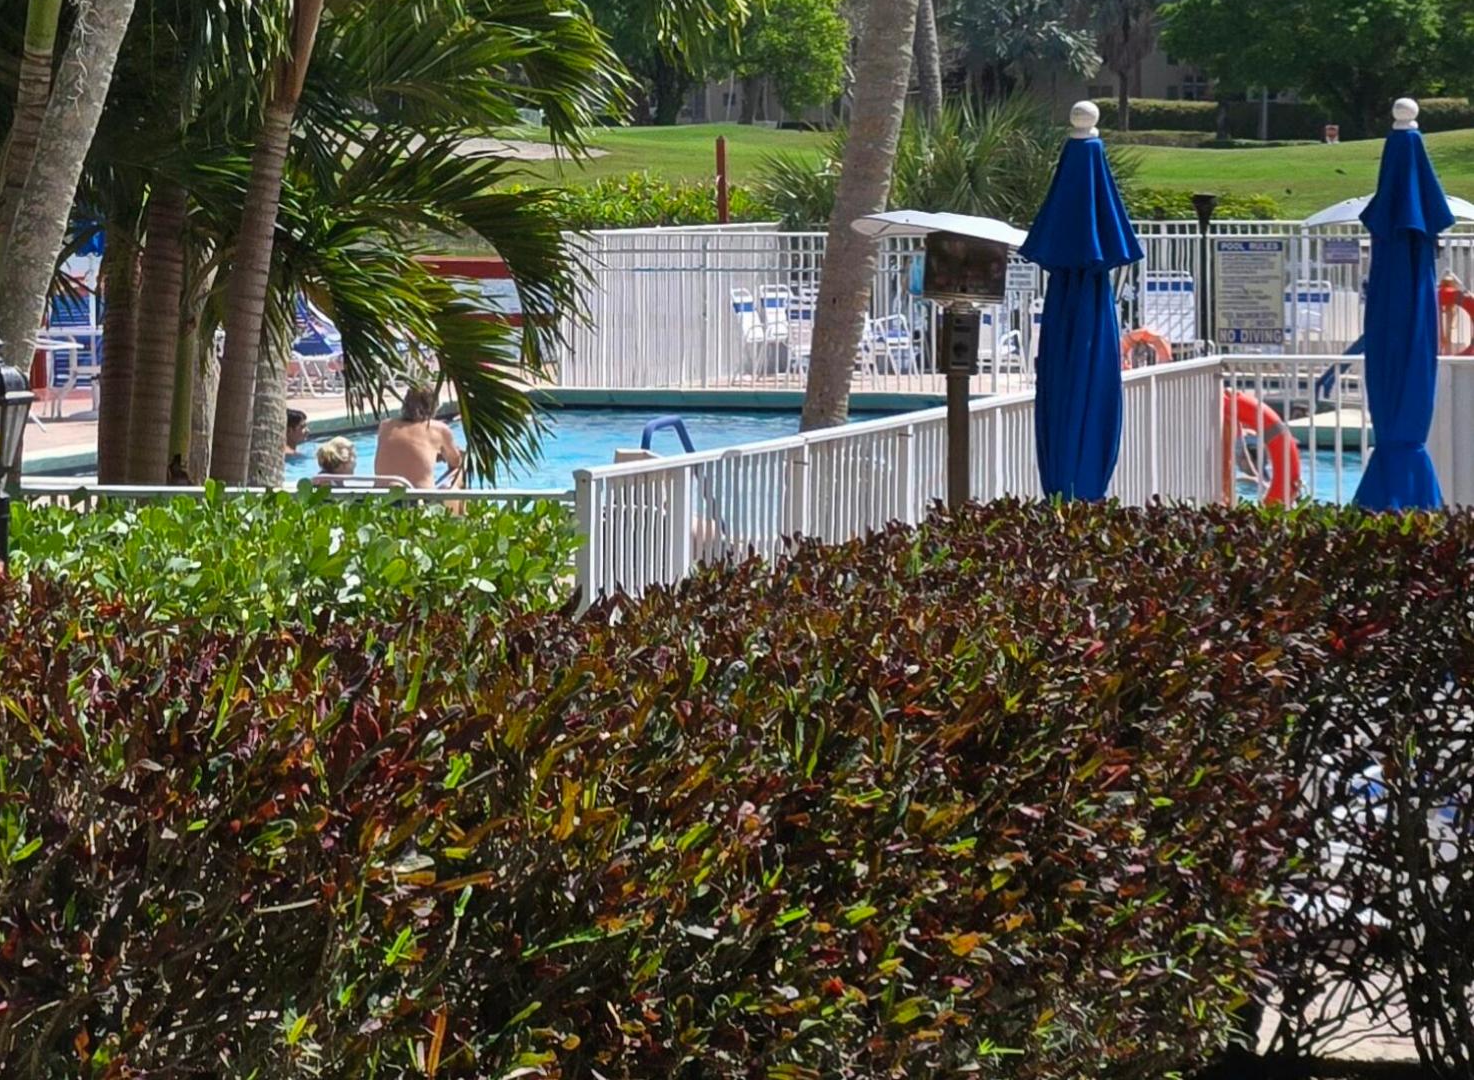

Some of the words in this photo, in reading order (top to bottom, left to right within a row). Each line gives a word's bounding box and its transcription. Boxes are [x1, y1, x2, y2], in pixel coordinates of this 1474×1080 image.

[1221, 242, 1244, 251] POOL
[1249, 242, 1279, 251] RULES
[1219, 328, 1236, 343] NO
[1240, 328, 1282, 343] DIVING
